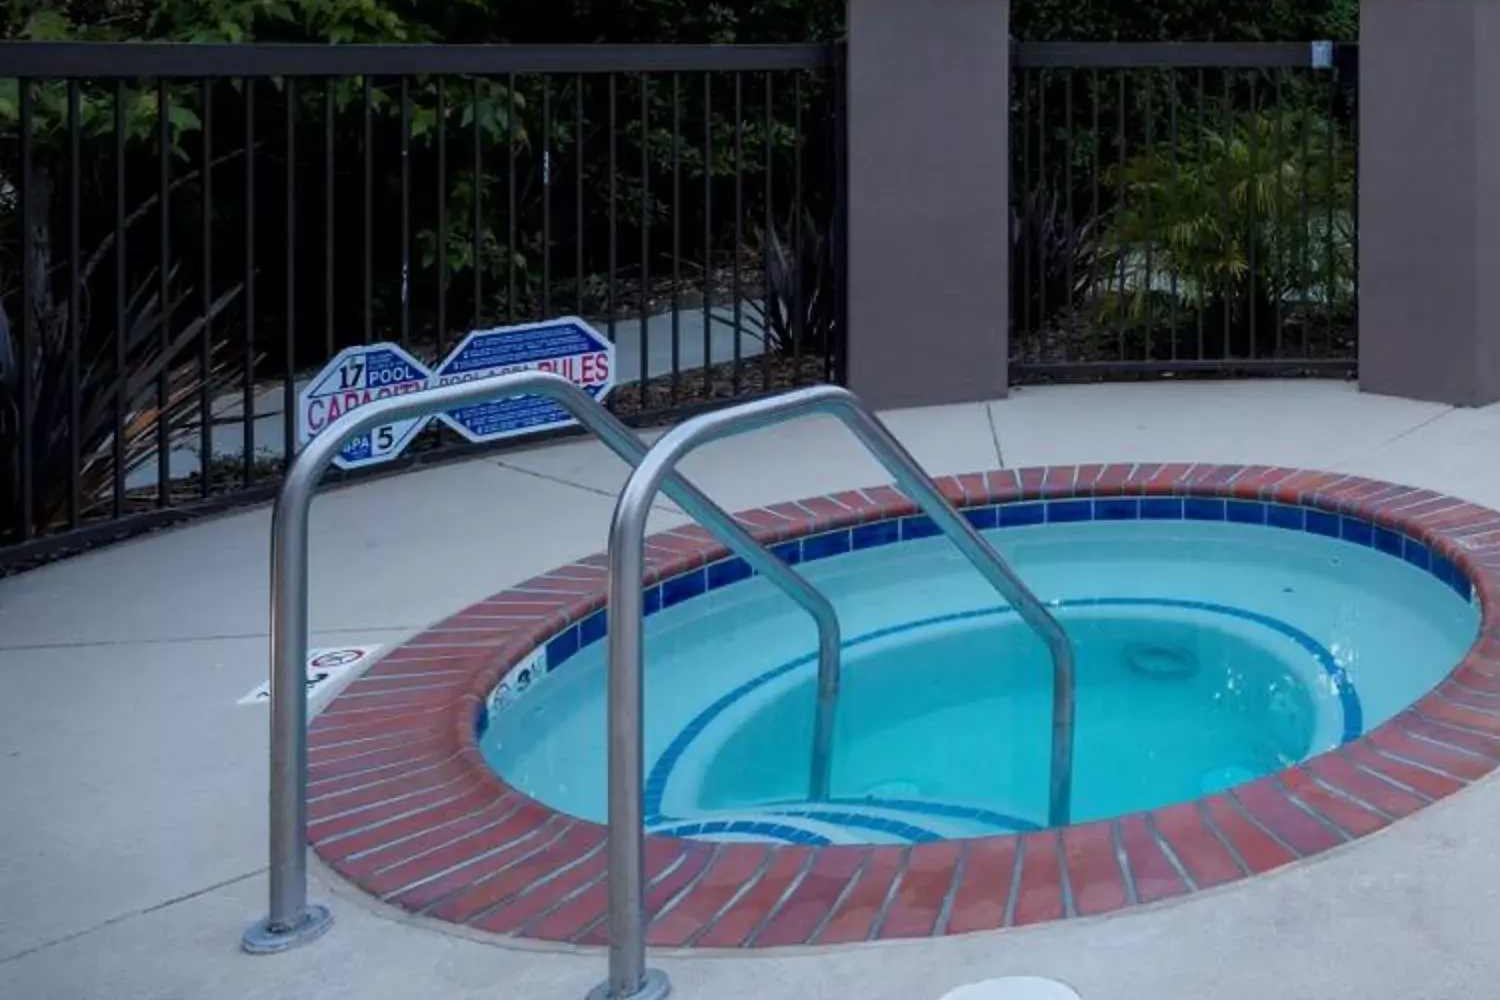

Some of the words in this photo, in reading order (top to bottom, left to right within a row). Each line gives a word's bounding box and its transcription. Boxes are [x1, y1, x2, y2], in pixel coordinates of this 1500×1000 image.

[339, 363, 364, 388] 17
[368, 363, 414, 385] POOL
[377, 426, 394, 450] 5
